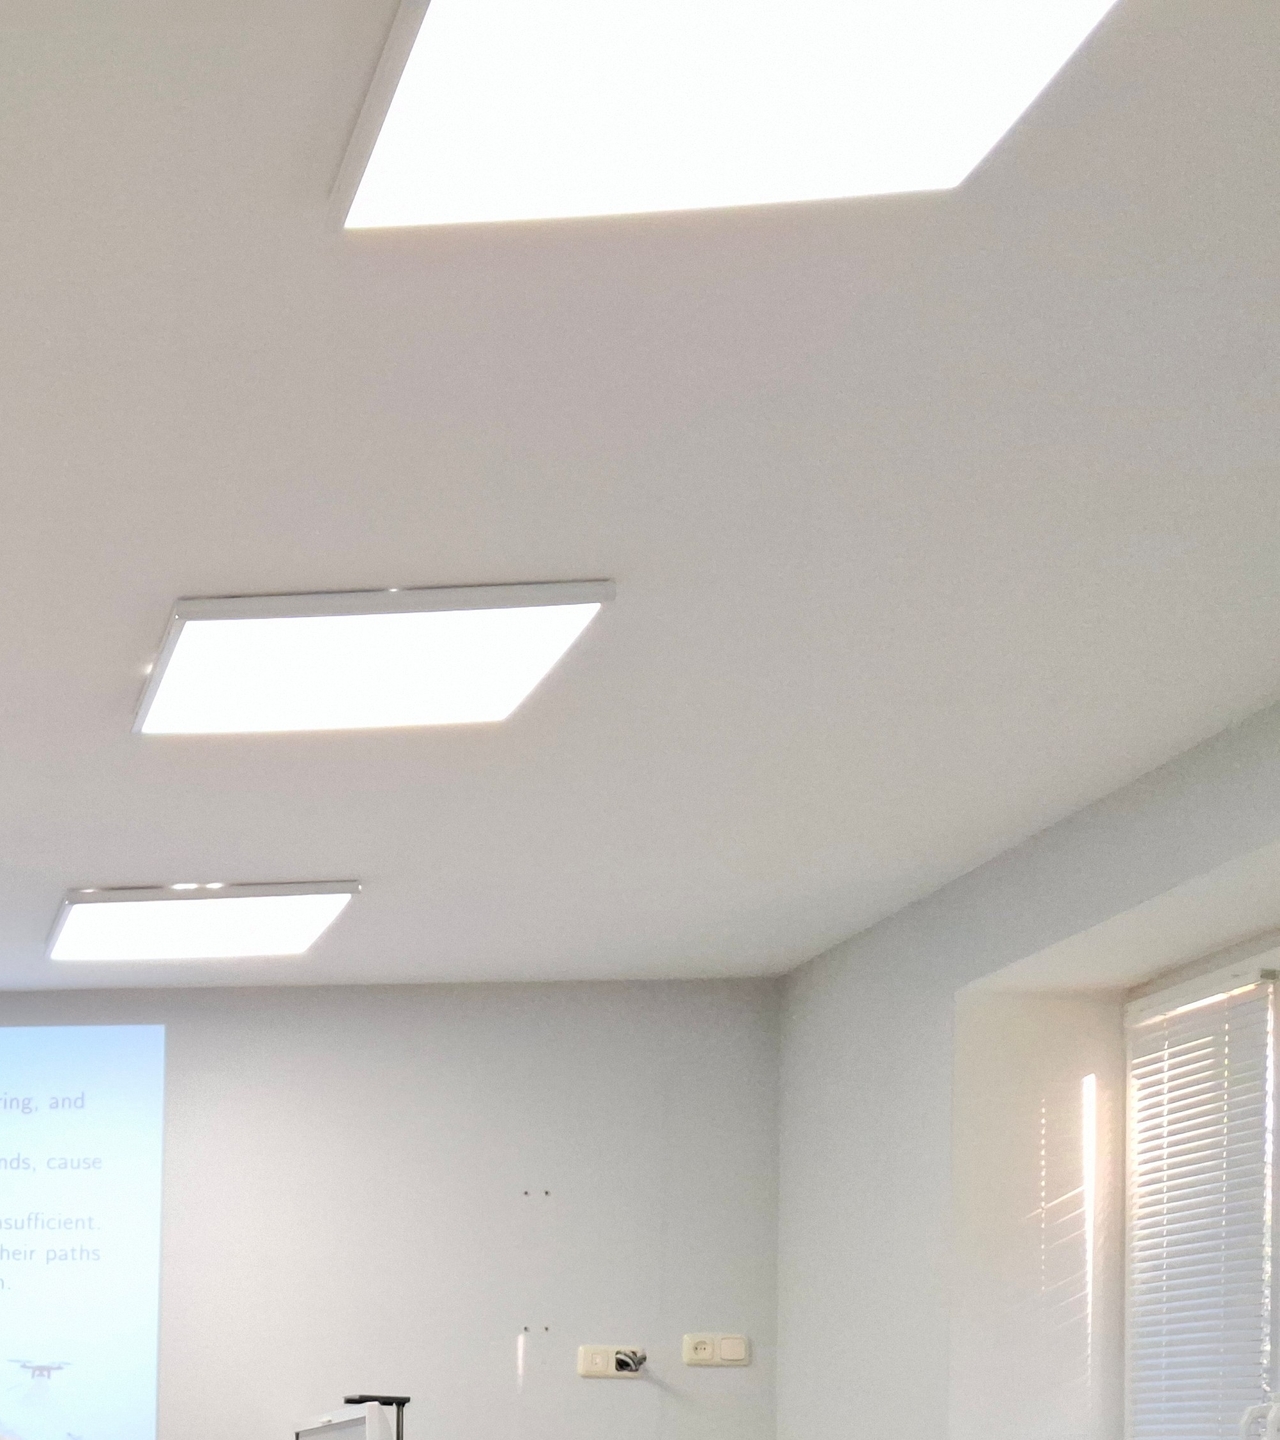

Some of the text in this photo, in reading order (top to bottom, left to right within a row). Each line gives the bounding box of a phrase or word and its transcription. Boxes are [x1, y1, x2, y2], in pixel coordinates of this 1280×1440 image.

[48, 1091, 86, 1111] and
[45, 1157, 103, 1172] cause
[45, 1245, 102, 1267] paths
